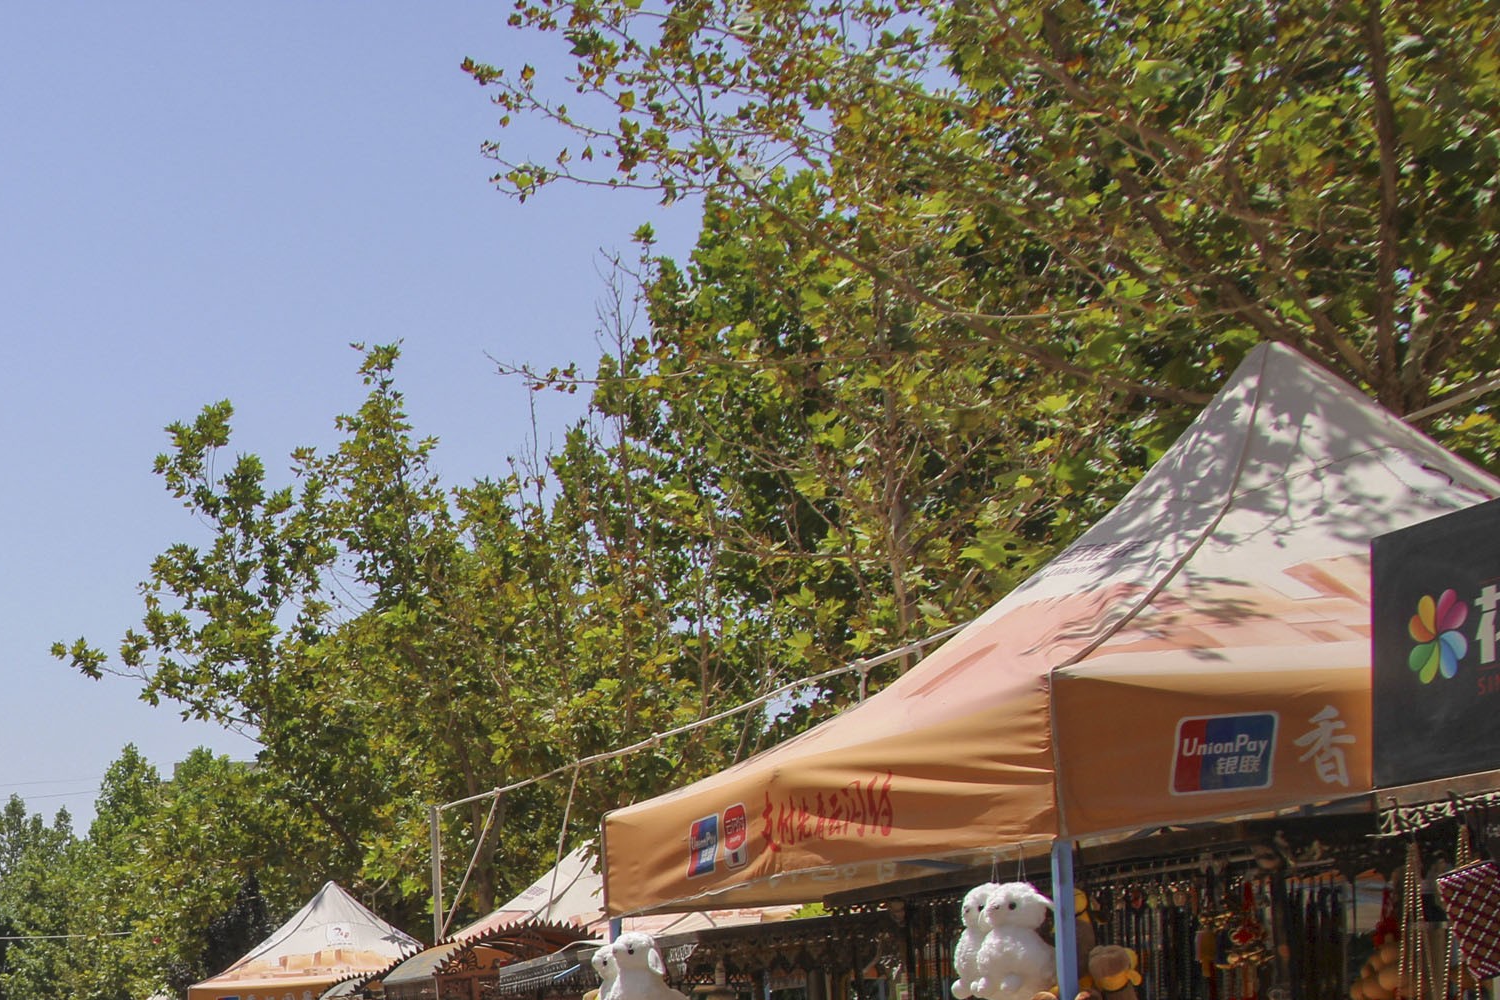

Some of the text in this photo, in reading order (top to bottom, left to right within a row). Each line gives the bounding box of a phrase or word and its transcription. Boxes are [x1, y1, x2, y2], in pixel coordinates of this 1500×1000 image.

[1181, 733, 1268, 759] UnionPay
[1293, 704, 1356, 787] 香
[1215, 755, 1262, 776] 银联
